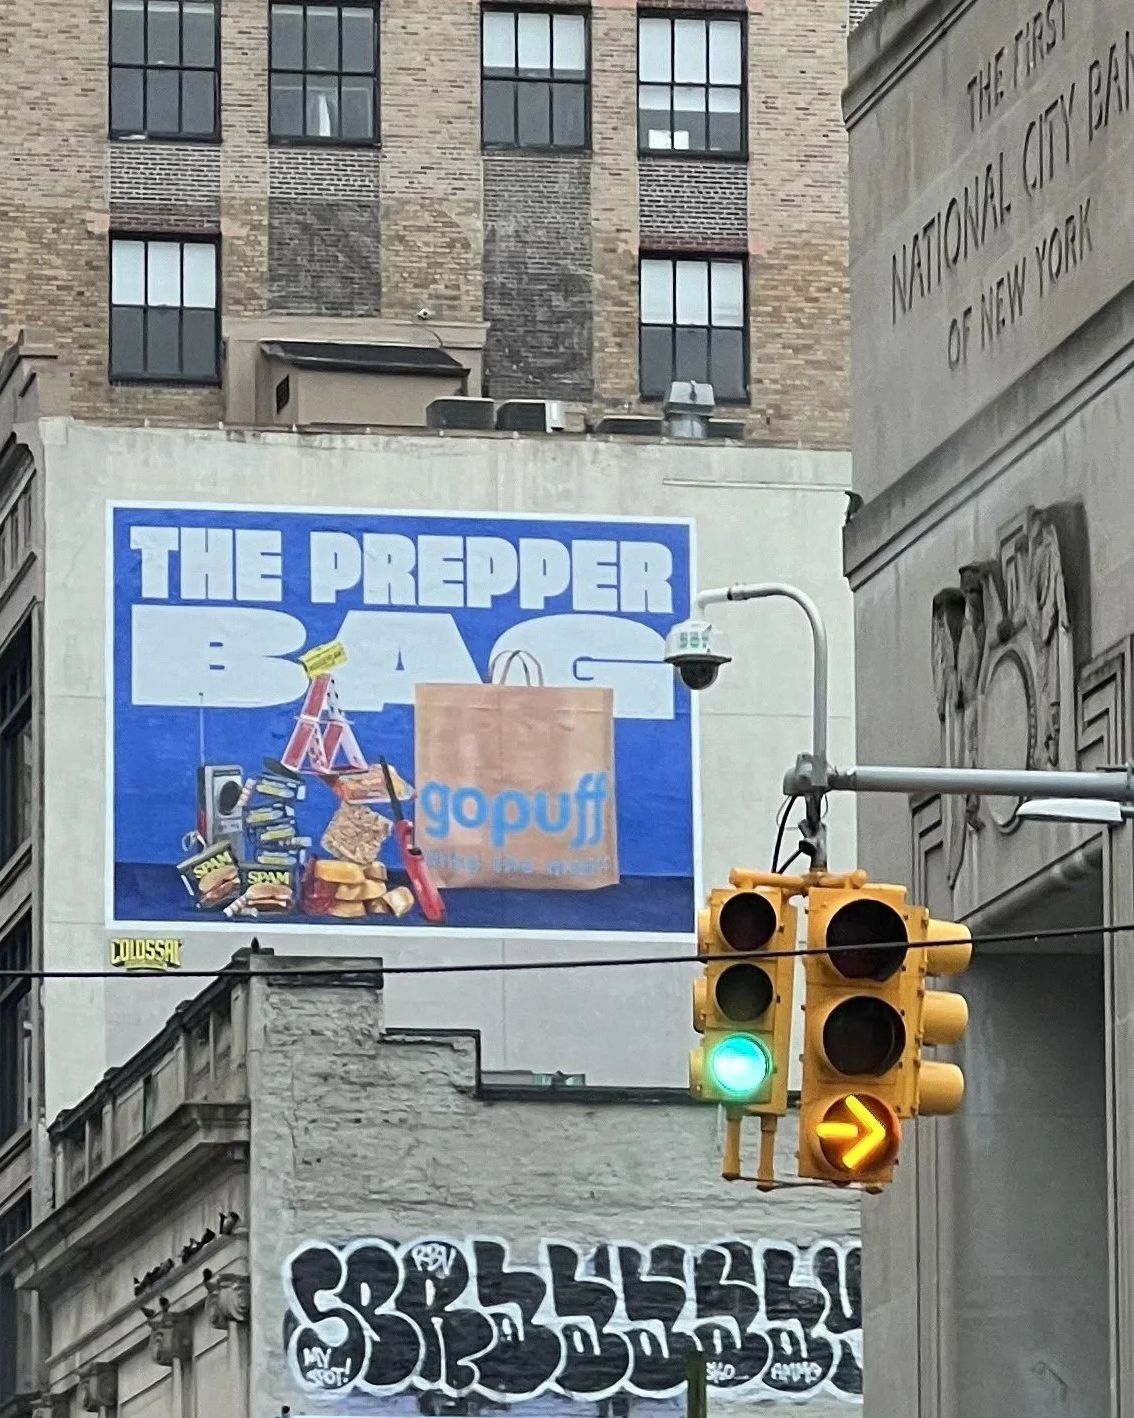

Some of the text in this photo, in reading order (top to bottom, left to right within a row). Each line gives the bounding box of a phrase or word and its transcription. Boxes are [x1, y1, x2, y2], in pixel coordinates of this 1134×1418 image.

[967, 0, 1066, 133] THE FIRST
[891, 152, 1012, 325] NATIONAL
[1022, 82, 1076, 197] CITY
[948, 197, 1093, 370] OF NEW YORK
[130, 526, 674, 614] THE PREPPER
[131, 604, 675, 720] BAG
[420, 771, 608, 848] gopuff
[192, 850, 233, 880] SPAM
[247, 870, 291, 886] SPAM
